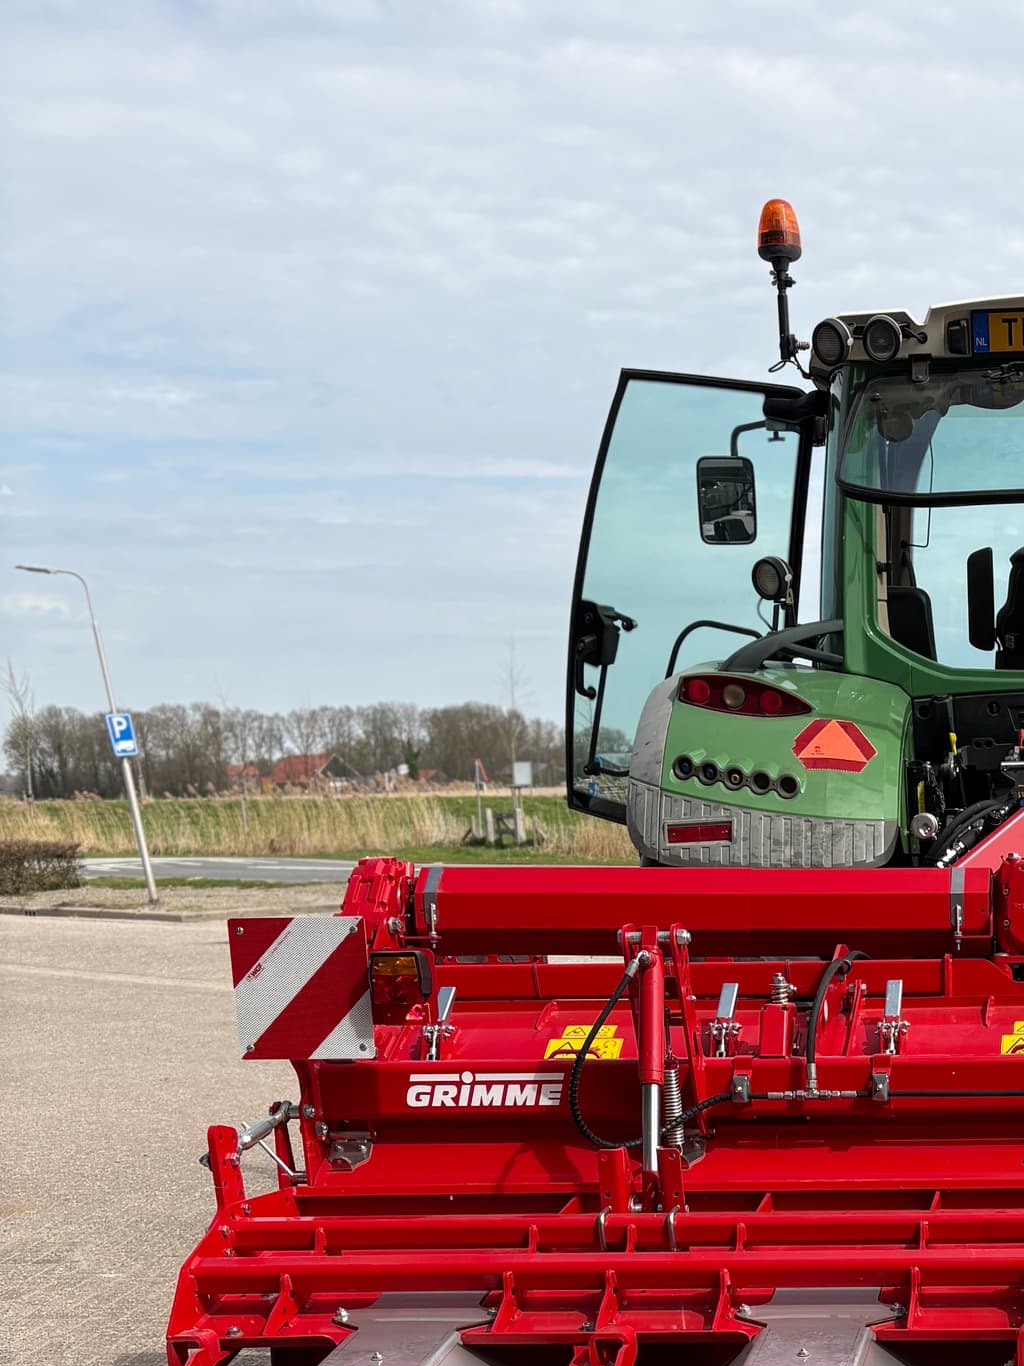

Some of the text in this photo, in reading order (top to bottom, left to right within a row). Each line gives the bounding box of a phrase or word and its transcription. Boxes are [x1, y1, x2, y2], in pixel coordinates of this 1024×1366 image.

[975, 336, 988, 346] NL
[111, 717, 128, 739] P
[405, 1070, 564, 1107] GRIMME
